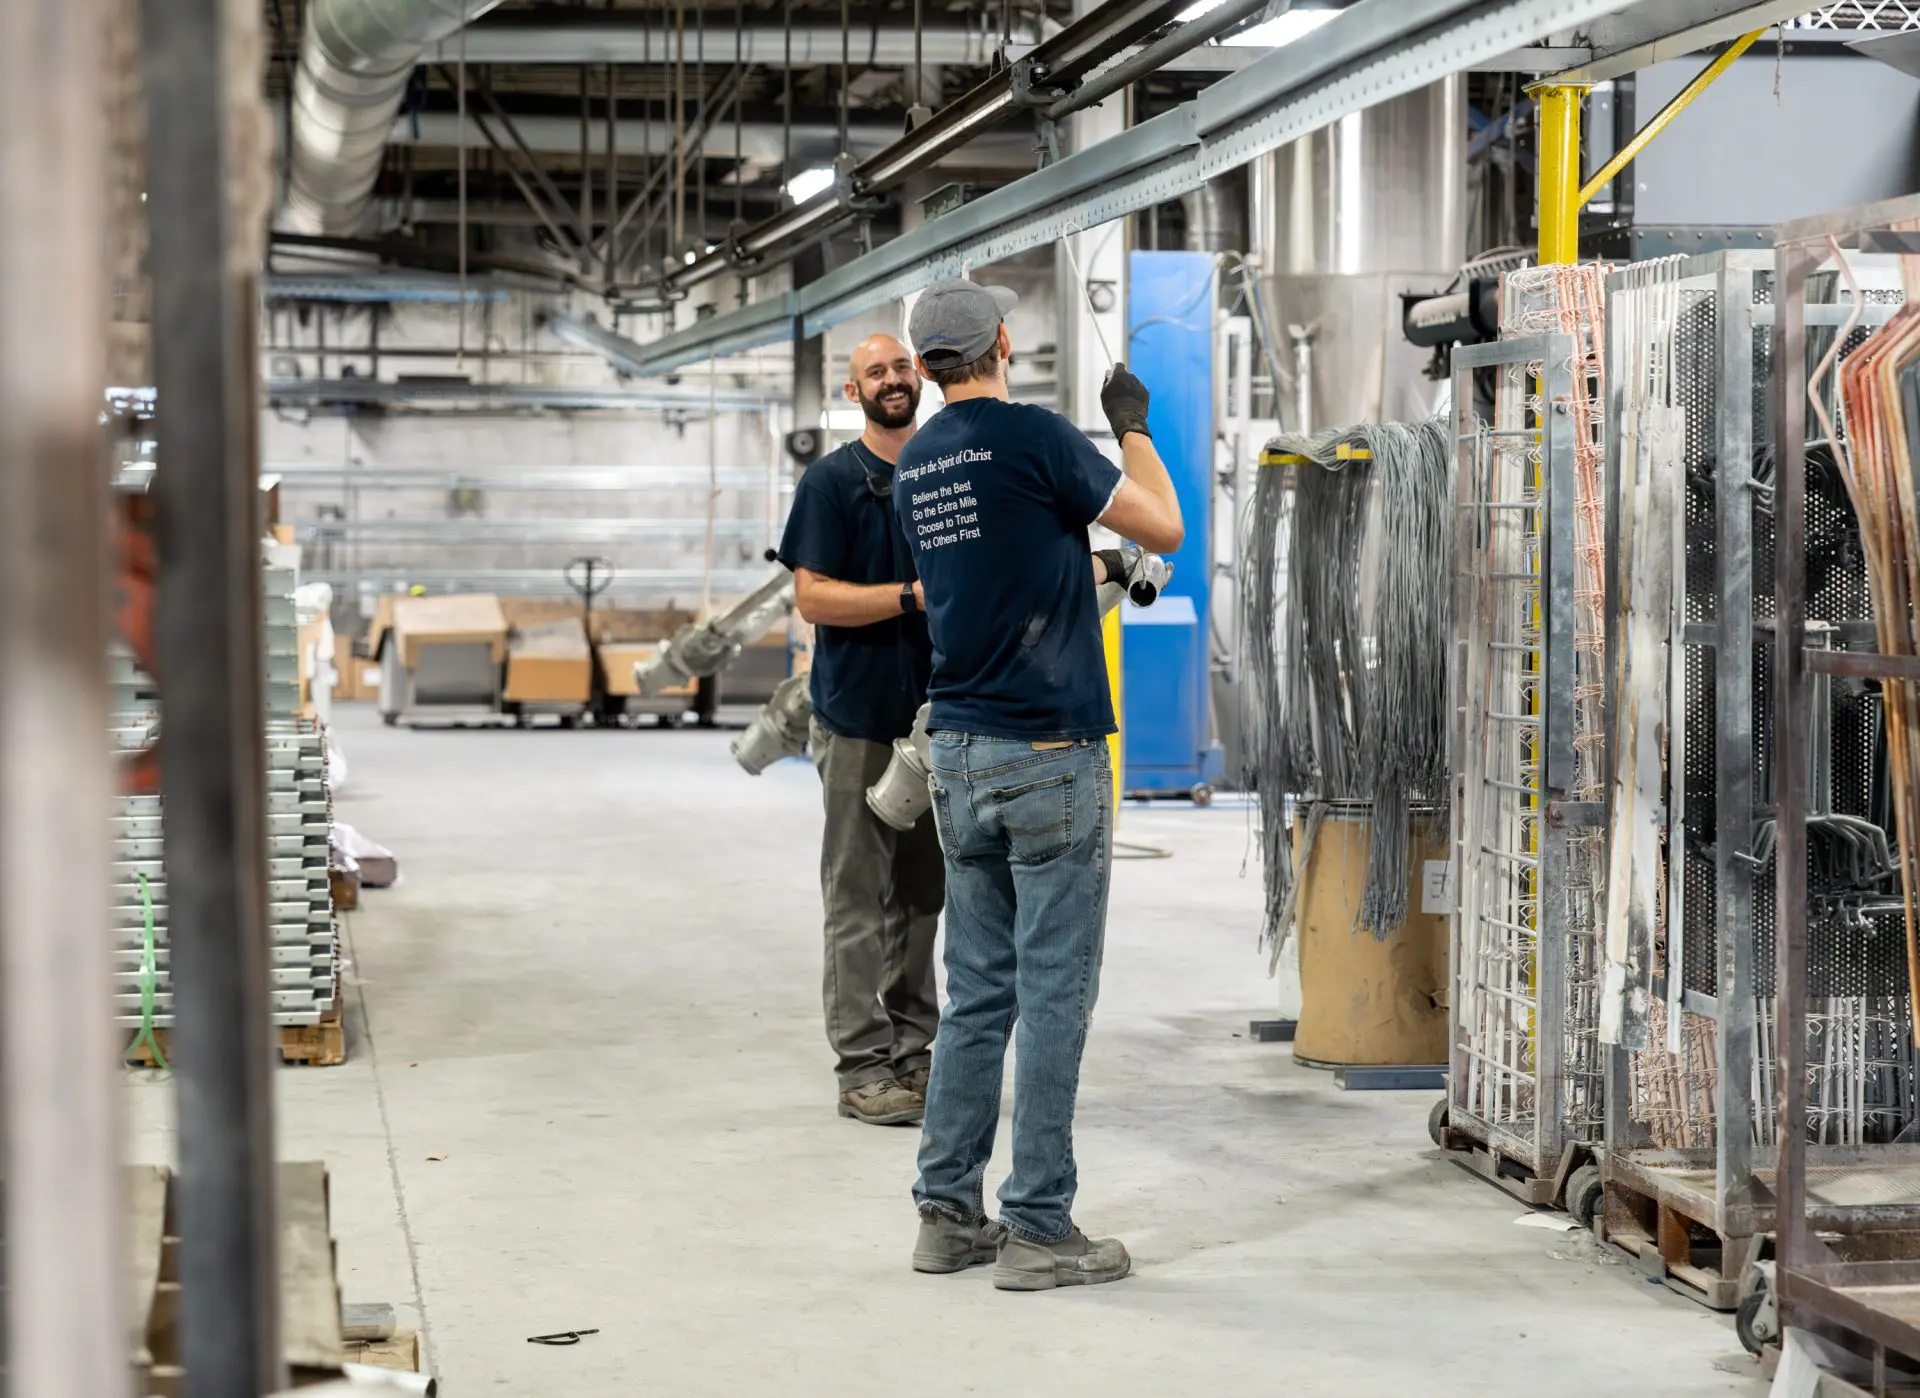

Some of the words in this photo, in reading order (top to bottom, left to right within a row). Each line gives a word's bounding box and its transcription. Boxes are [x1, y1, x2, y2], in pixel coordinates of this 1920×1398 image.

[899, 466, 919, 482] Serving
[920, 463, 926, 476] in
[927, 461, 937, 473] the
[938, 454, 955, 473] Spirit
[956, 451, 962, 464] of
[963, 448, 992, 463] Christ
[912, 490, 938, 505] Believe
[940, 486, 952, 497] the
[953, 480, 971, 494] Best
[913, 510, 923, 521] Go
[924, 507, 936, 518] the
[938, 501, 958, 514] Extra
[960, 496, 977, 508] Mile
[917, 521, 944, 536] Choose
[946, 518, 953, 528] to
[955, 512, 978, 525] Trust
[920, 539, 931, 551] Put
[933, 533, 957, 547] Others
[960, 527, 981, 540] First
